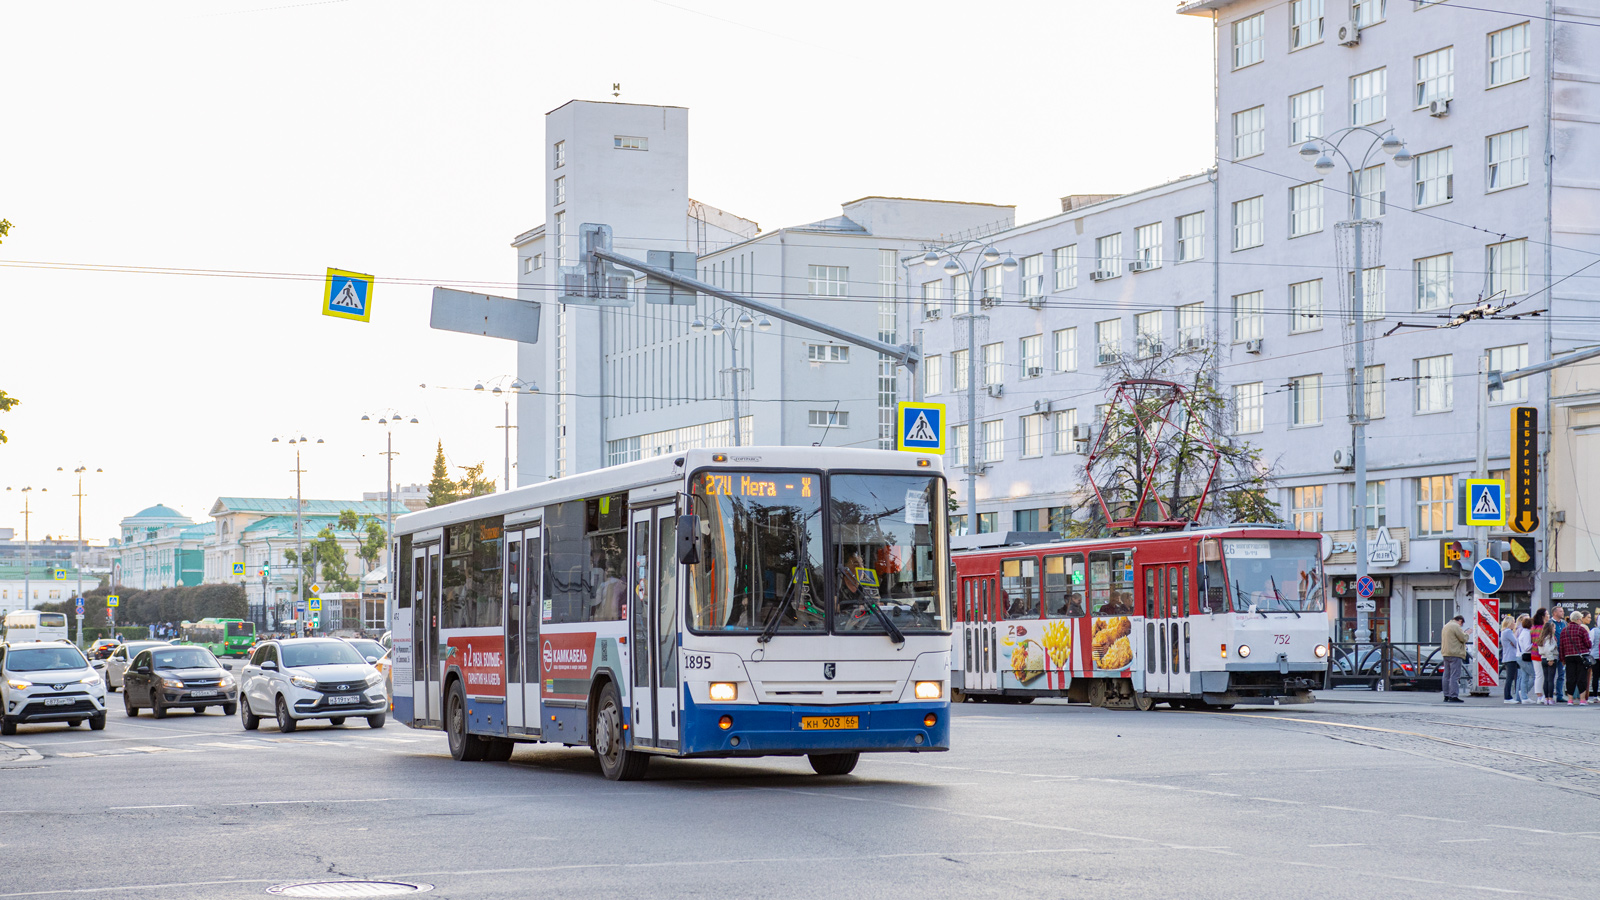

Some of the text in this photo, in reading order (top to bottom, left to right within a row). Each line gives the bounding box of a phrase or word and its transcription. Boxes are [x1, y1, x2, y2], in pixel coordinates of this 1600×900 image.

[741, 475, 777, 497] Мега
[1223, 543, 1235, 555] 26
[1273, 634, 1291, 645] 752
[467, 643, 473, 667] 2
[473, 652, 483, 667] РАЗА
[484, 652, 500, 667] БОЛЬШЕ
[553, 649, 587, 663] КАМКАБЕЛЬ
[684, 655, 712, 669] 1895
[822, 718, 841, 728] 903
